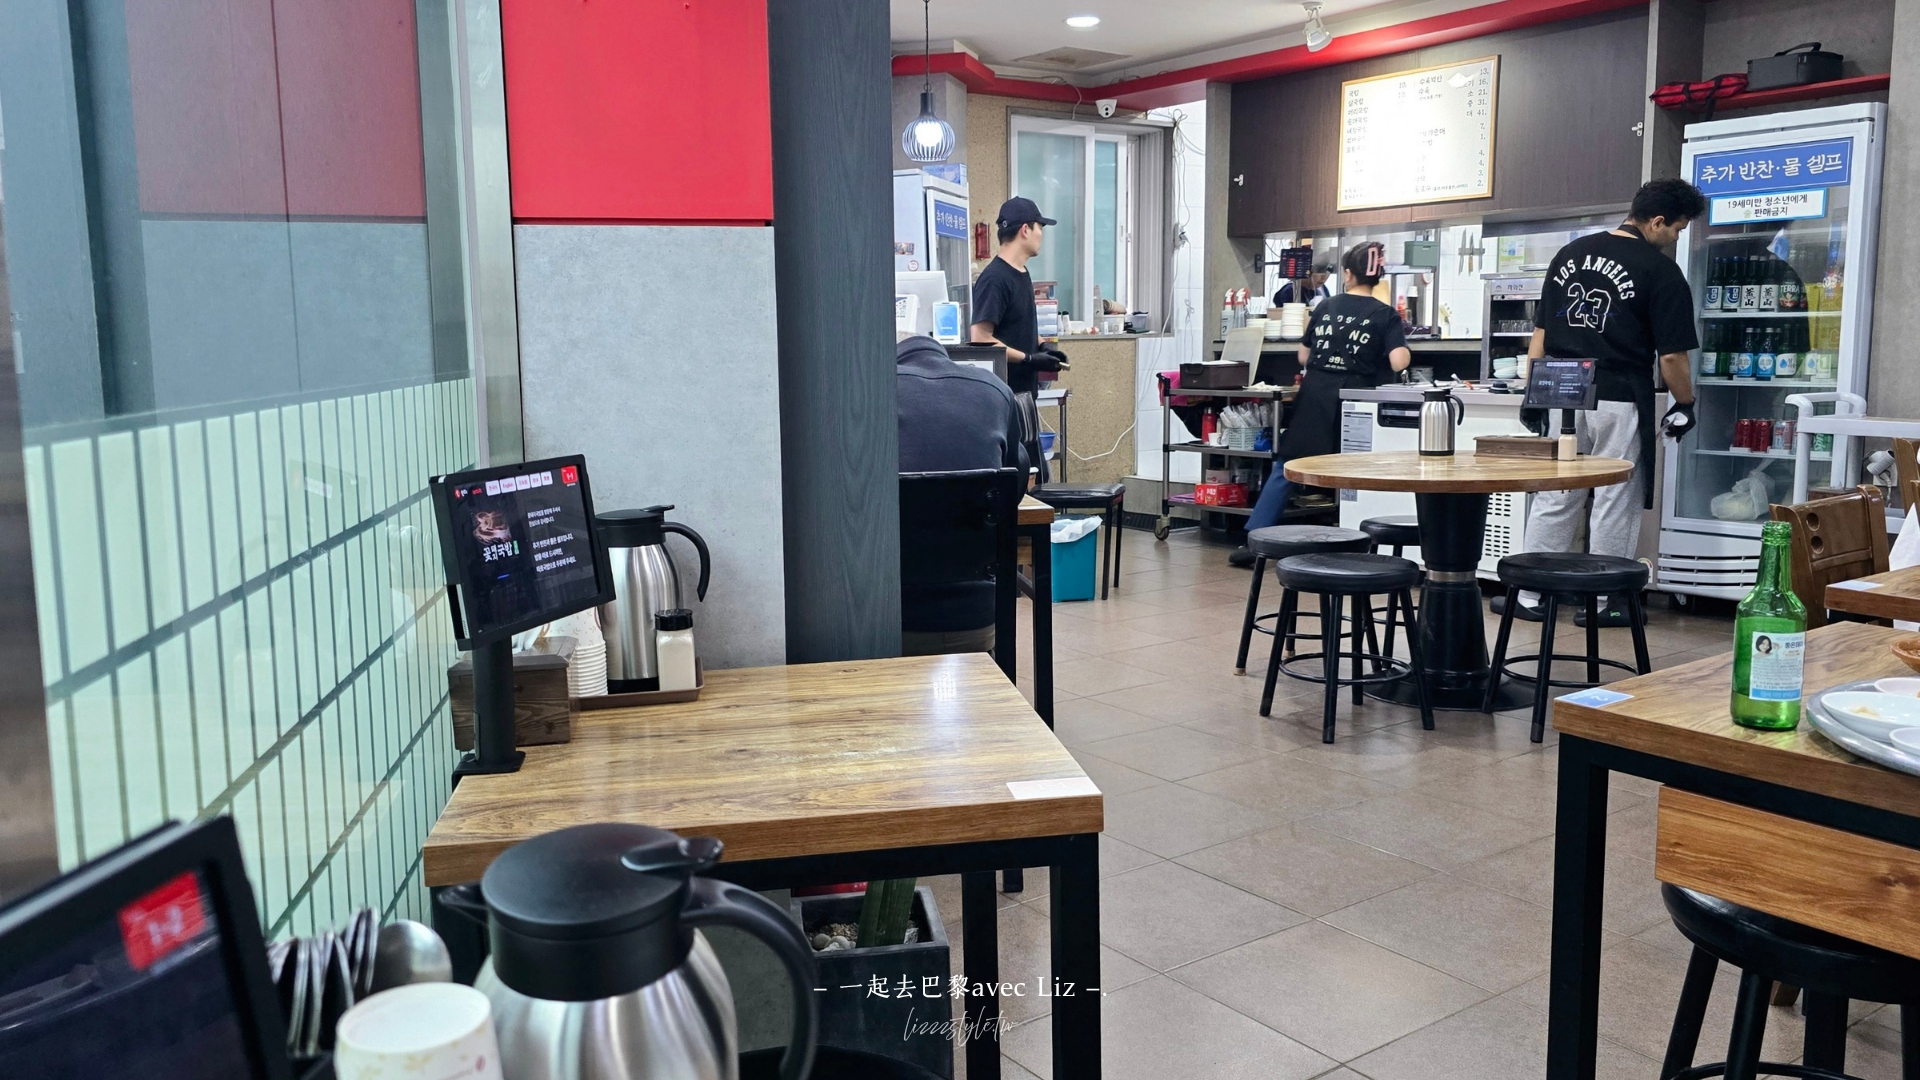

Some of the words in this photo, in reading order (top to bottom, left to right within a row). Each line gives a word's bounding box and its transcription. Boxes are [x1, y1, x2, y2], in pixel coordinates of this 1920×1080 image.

[1700, 164, 1735, 184] 추가
[1807, 153, 1843, 175] 셀프
[1727, 199, 1763, 209] 19세미만
[1765, 194, 1808, 206] 청소년에게
[1754, 207, 1788, 218] 판매금지
[1553, 259, 1576, 287] LOS
[1581, 254, 1635, 301] ANGELES
[1780, 284, 1800, 294] TERRA
[1566, 282, 1612, 334] 23
